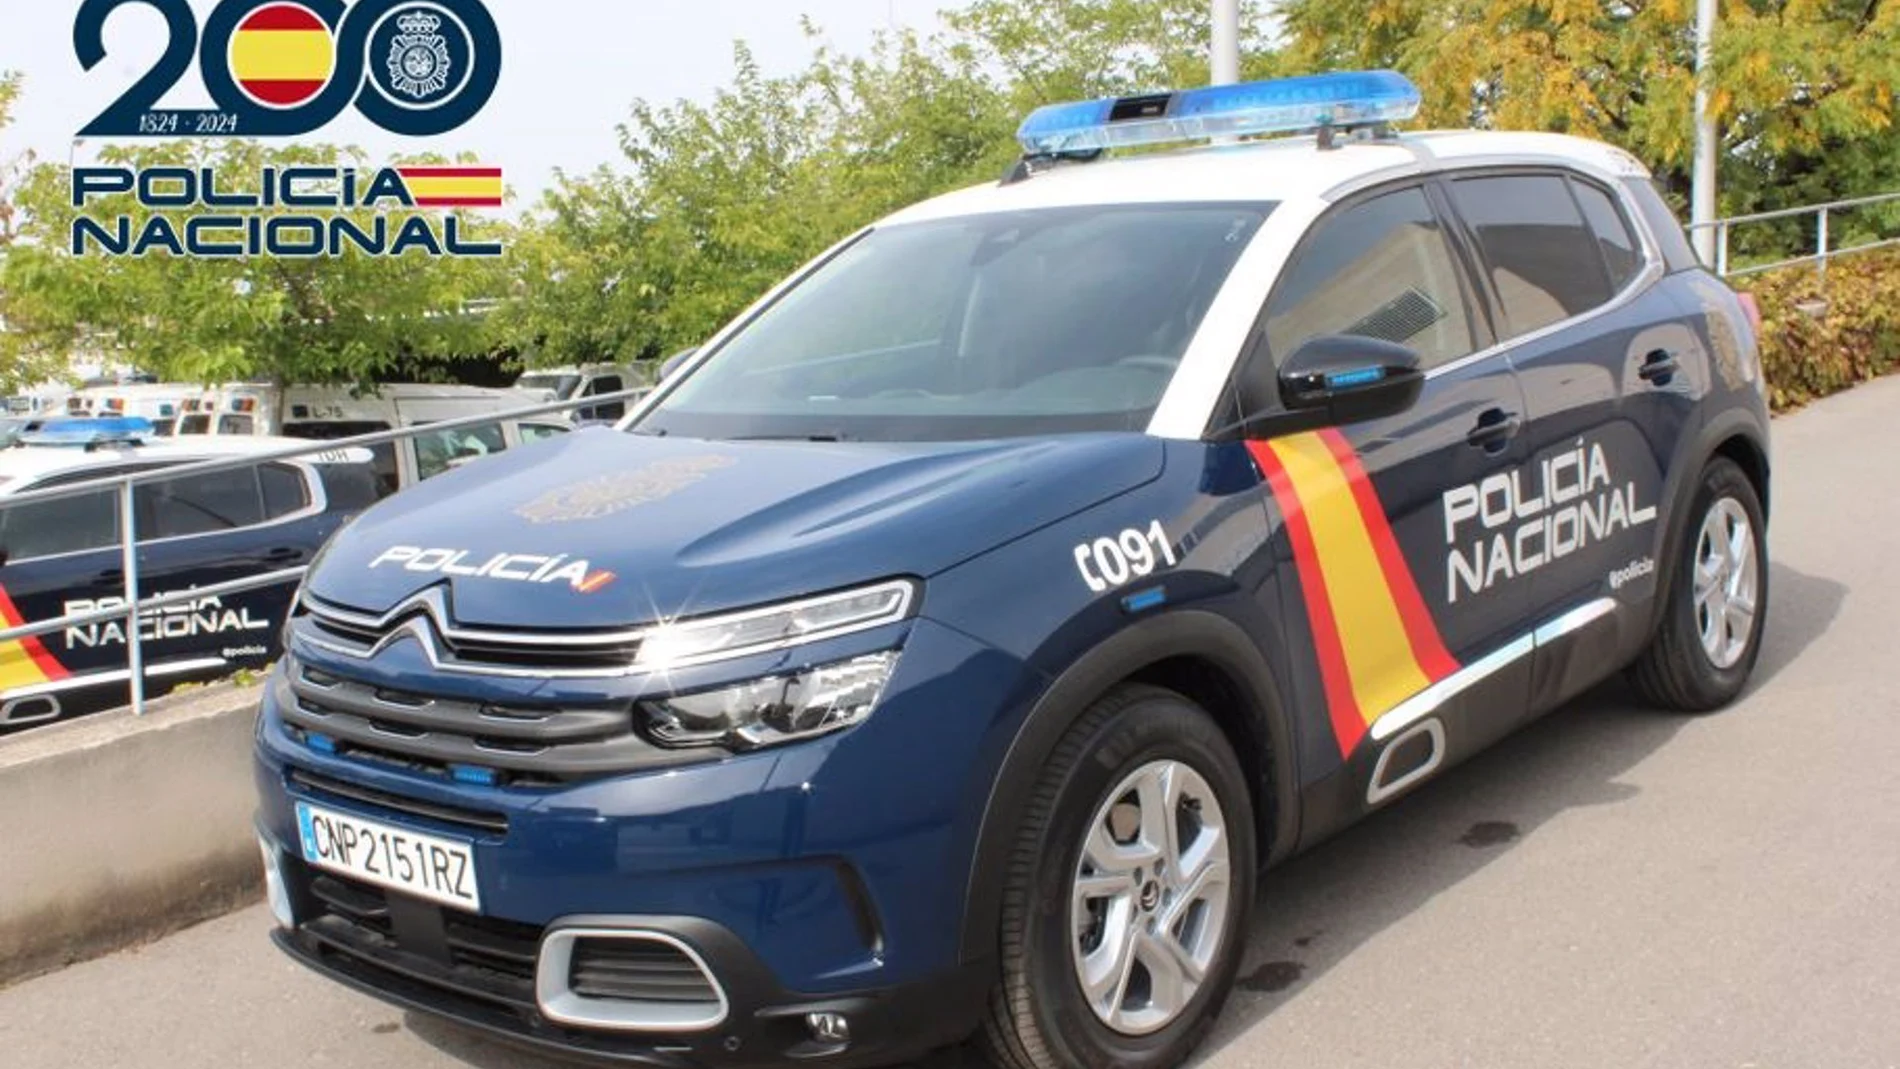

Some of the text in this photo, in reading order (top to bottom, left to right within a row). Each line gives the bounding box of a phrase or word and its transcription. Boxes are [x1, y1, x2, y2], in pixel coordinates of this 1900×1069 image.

[1443, 435, 1611, 544] POLICÍA
[367, 545, 590, 586] POLICÍA
[1448, 481, 1657, 603] NACIONAL
[312, 815, 473, 899] CNP2151RZ
